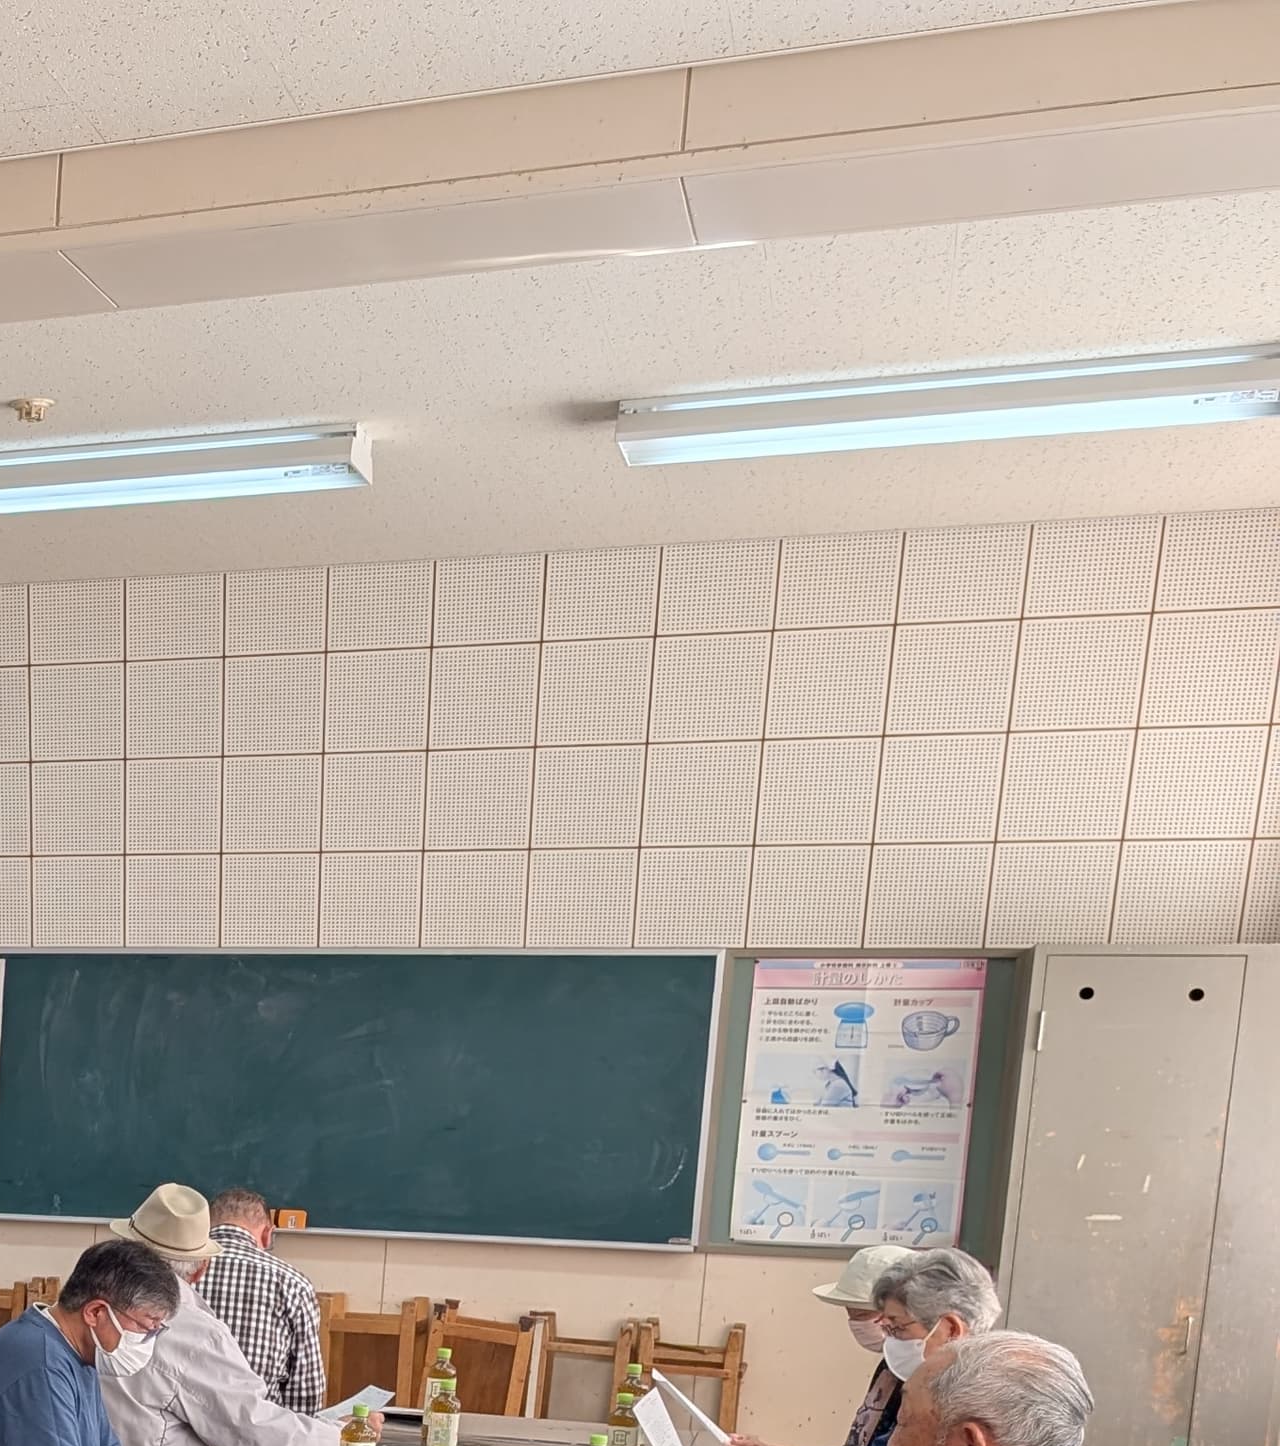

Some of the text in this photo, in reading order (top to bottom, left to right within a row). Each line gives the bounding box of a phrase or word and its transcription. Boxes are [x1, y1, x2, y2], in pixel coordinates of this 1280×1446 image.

[814, 972, 904, 986] 計量のしかた
[893, 997, 934, 1007] 計量カップ
[751, 1130, 798, 1138] 計量スプーン
